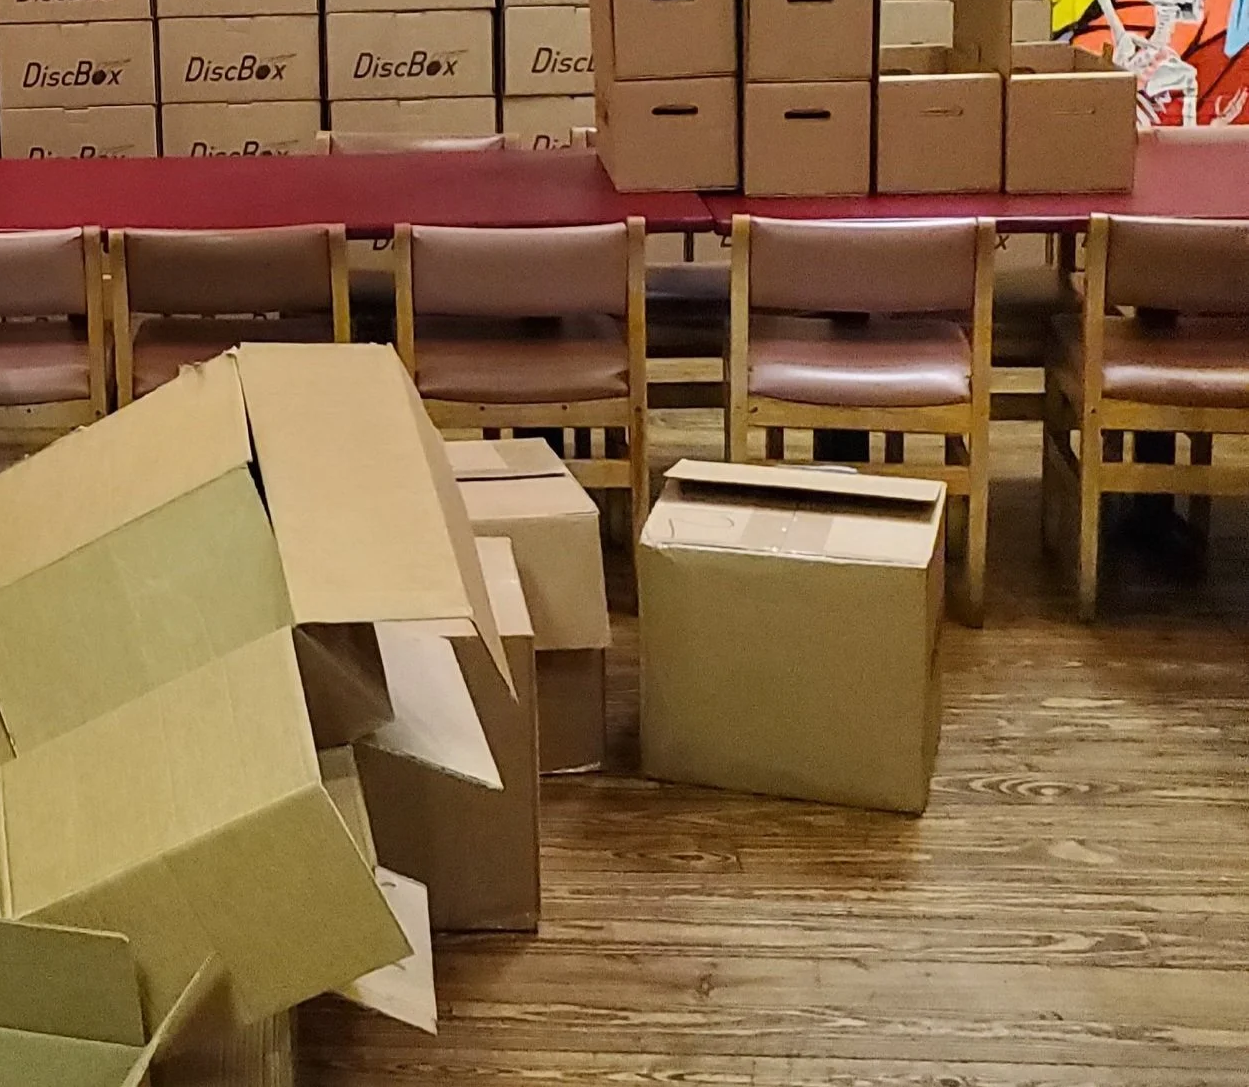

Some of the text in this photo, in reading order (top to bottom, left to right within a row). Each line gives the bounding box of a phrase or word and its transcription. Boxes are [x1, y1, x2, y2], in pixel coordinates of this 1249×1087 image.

[22, 60, 123, 88] DiscBox
[184, 54, 287, 83] DiscBox
[353, 50, 458, 79] DiscBox
[531, 47, 595, 74] Disc
